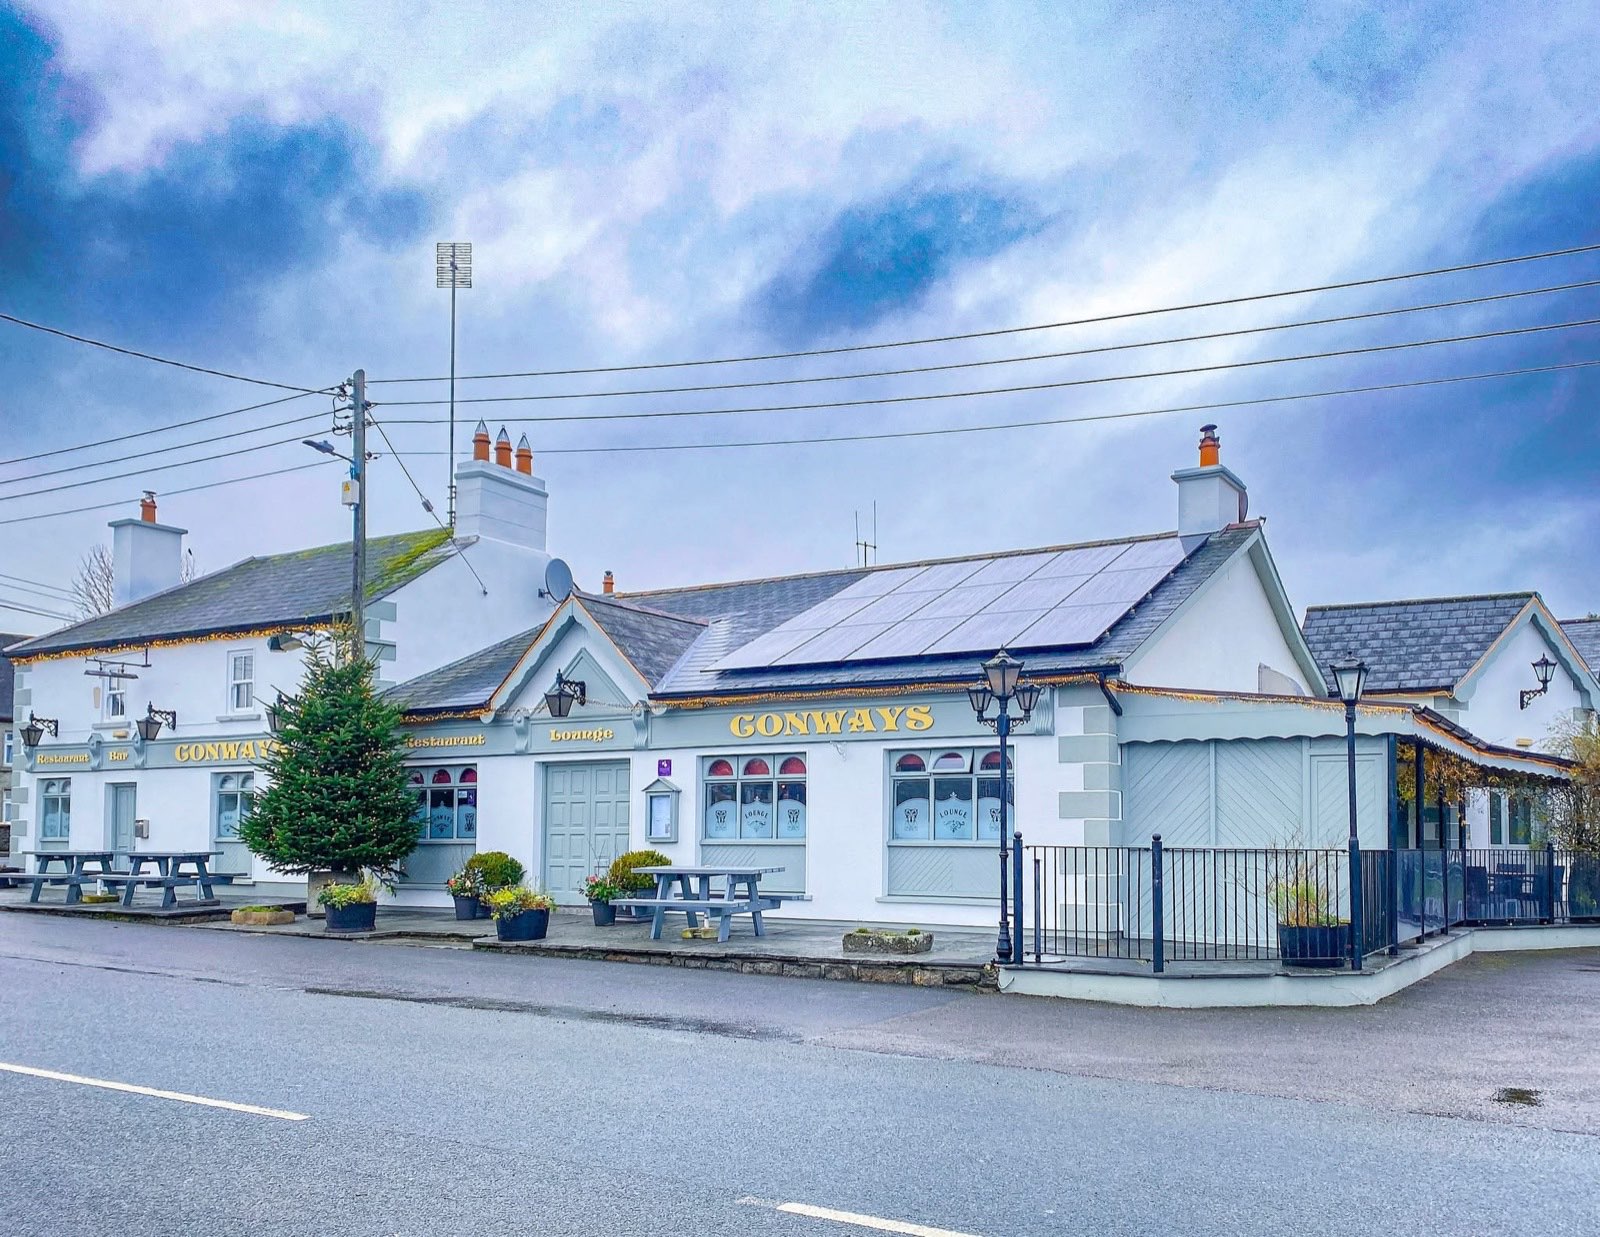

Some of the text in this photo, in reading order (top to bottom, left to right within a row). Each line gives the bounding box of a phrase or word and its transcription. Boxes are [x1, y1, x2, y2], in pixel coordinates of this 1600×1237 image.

[729, 705, 935, 738] CONWAYS
[550, 727, 614, 743] Lounge
[37, 753, 89, 765] Restaurant
[109, 751, 129, 762] Bar
[743, 809, 769, 820] LOUNGE
[939, 808, 968, 819] LOUNGE
